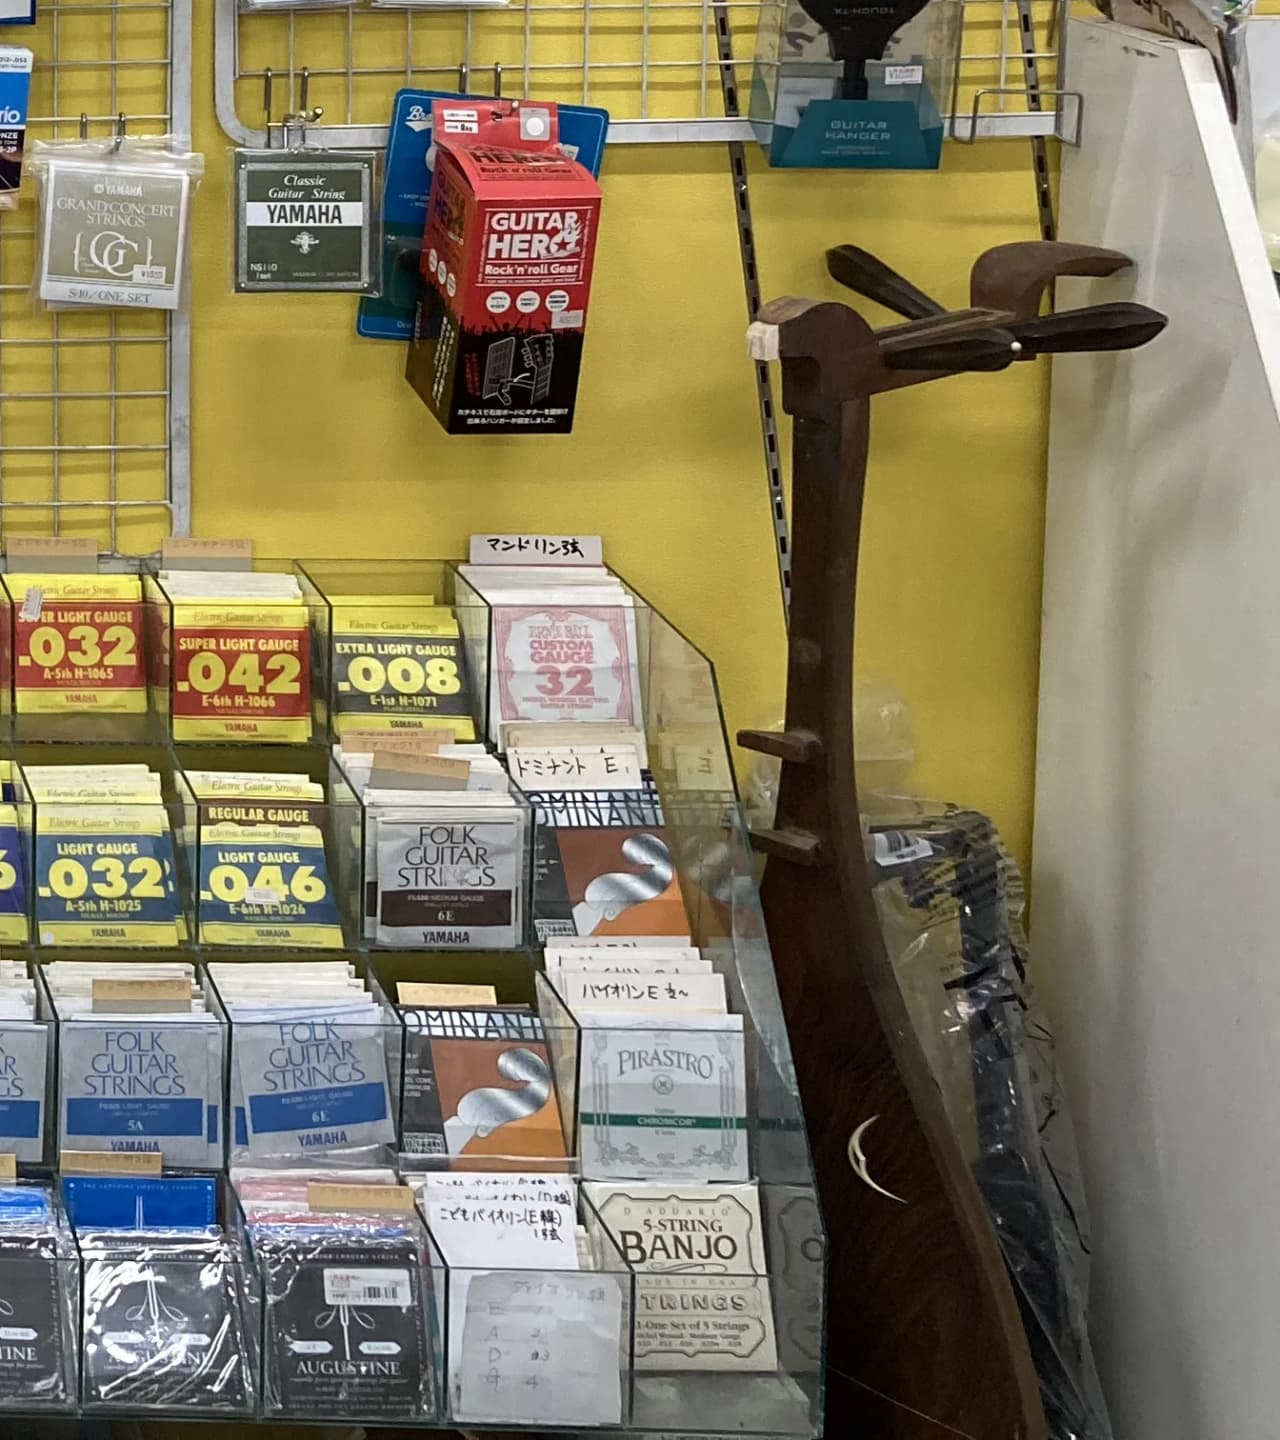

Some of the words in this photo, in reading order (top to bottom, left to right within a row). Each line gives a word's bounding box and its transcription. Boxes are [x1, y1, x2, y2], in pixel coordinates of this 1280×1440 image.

[57, 196, 111, 215] GRAND
[113, 202, 177, 218] CONCERT
[266, 204, 343, 224] YAMAHA
[87, 212, 146, 228] STRINGS
[491, 212, 579, 232] GUITAR
[485, 262, 548, 277] Rock'n'roll
[551, 263, 579, 274] Gear
[529, 639, 593, 651] CUSTOM
[530, 651, 593, 664] GAUGE
[176, 651, 301, 694] .042
[337, 657, 461, 695] .008
[535, 665, 596, 696] 32
[518, 757, 587, 778] ドミナント
[208, 807, 264, 821] REGULAR
[267, 808, 309, 822] GAUGE
[617, 1048, 714, 1079] PIRASTRO
[643, 1218, 723, 1234] 5-STRING
[619, 1231, 738, 1264] BANJO
